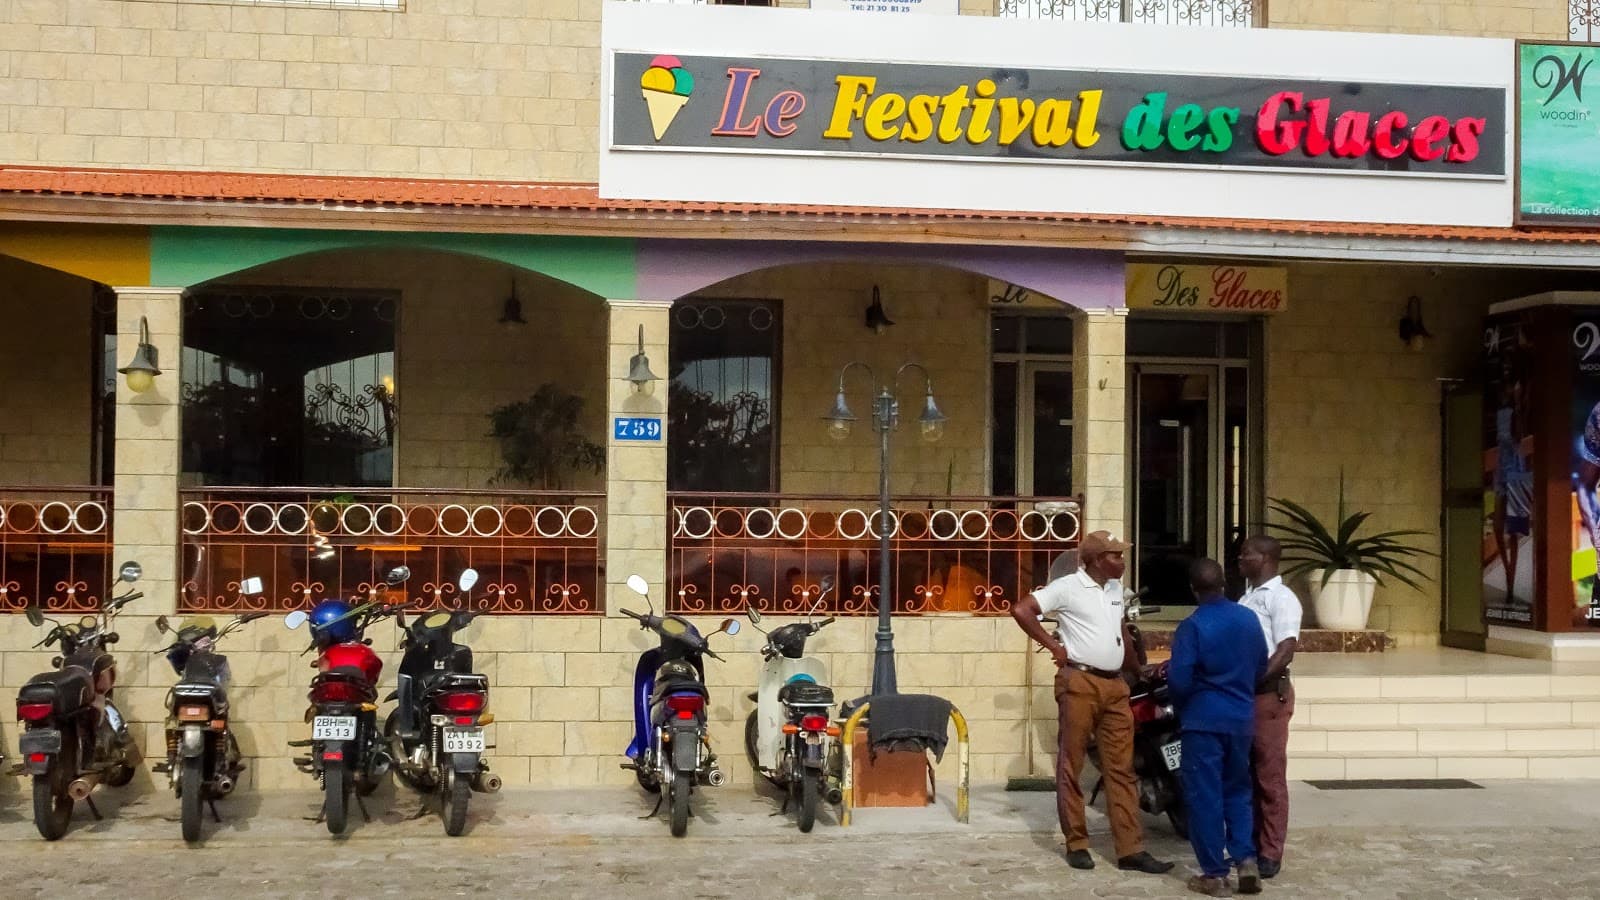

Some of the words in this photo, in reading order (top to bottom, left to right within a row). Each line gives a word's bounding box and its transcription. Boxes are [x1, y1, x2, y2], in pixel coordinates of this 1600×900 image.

[711, 67, 806, 137] Le
[823, 75, 1103, 148] Festival
[1120, 92, 1240, 153] des
[1255, 90, 1486, 163] Glaces
[1531, 204, 1542, 214] La
[1544, 206, 1590, 216] collection
[1153, 264, 1200, 307] Des
[1208, 264, 1282, 310] Glaces
[618, 420, 660, 437] 759
[316, 718, 337, 727] 2BH
[317, 728, 350, 737] 1513
[448, 740, 482, 750] 0392
